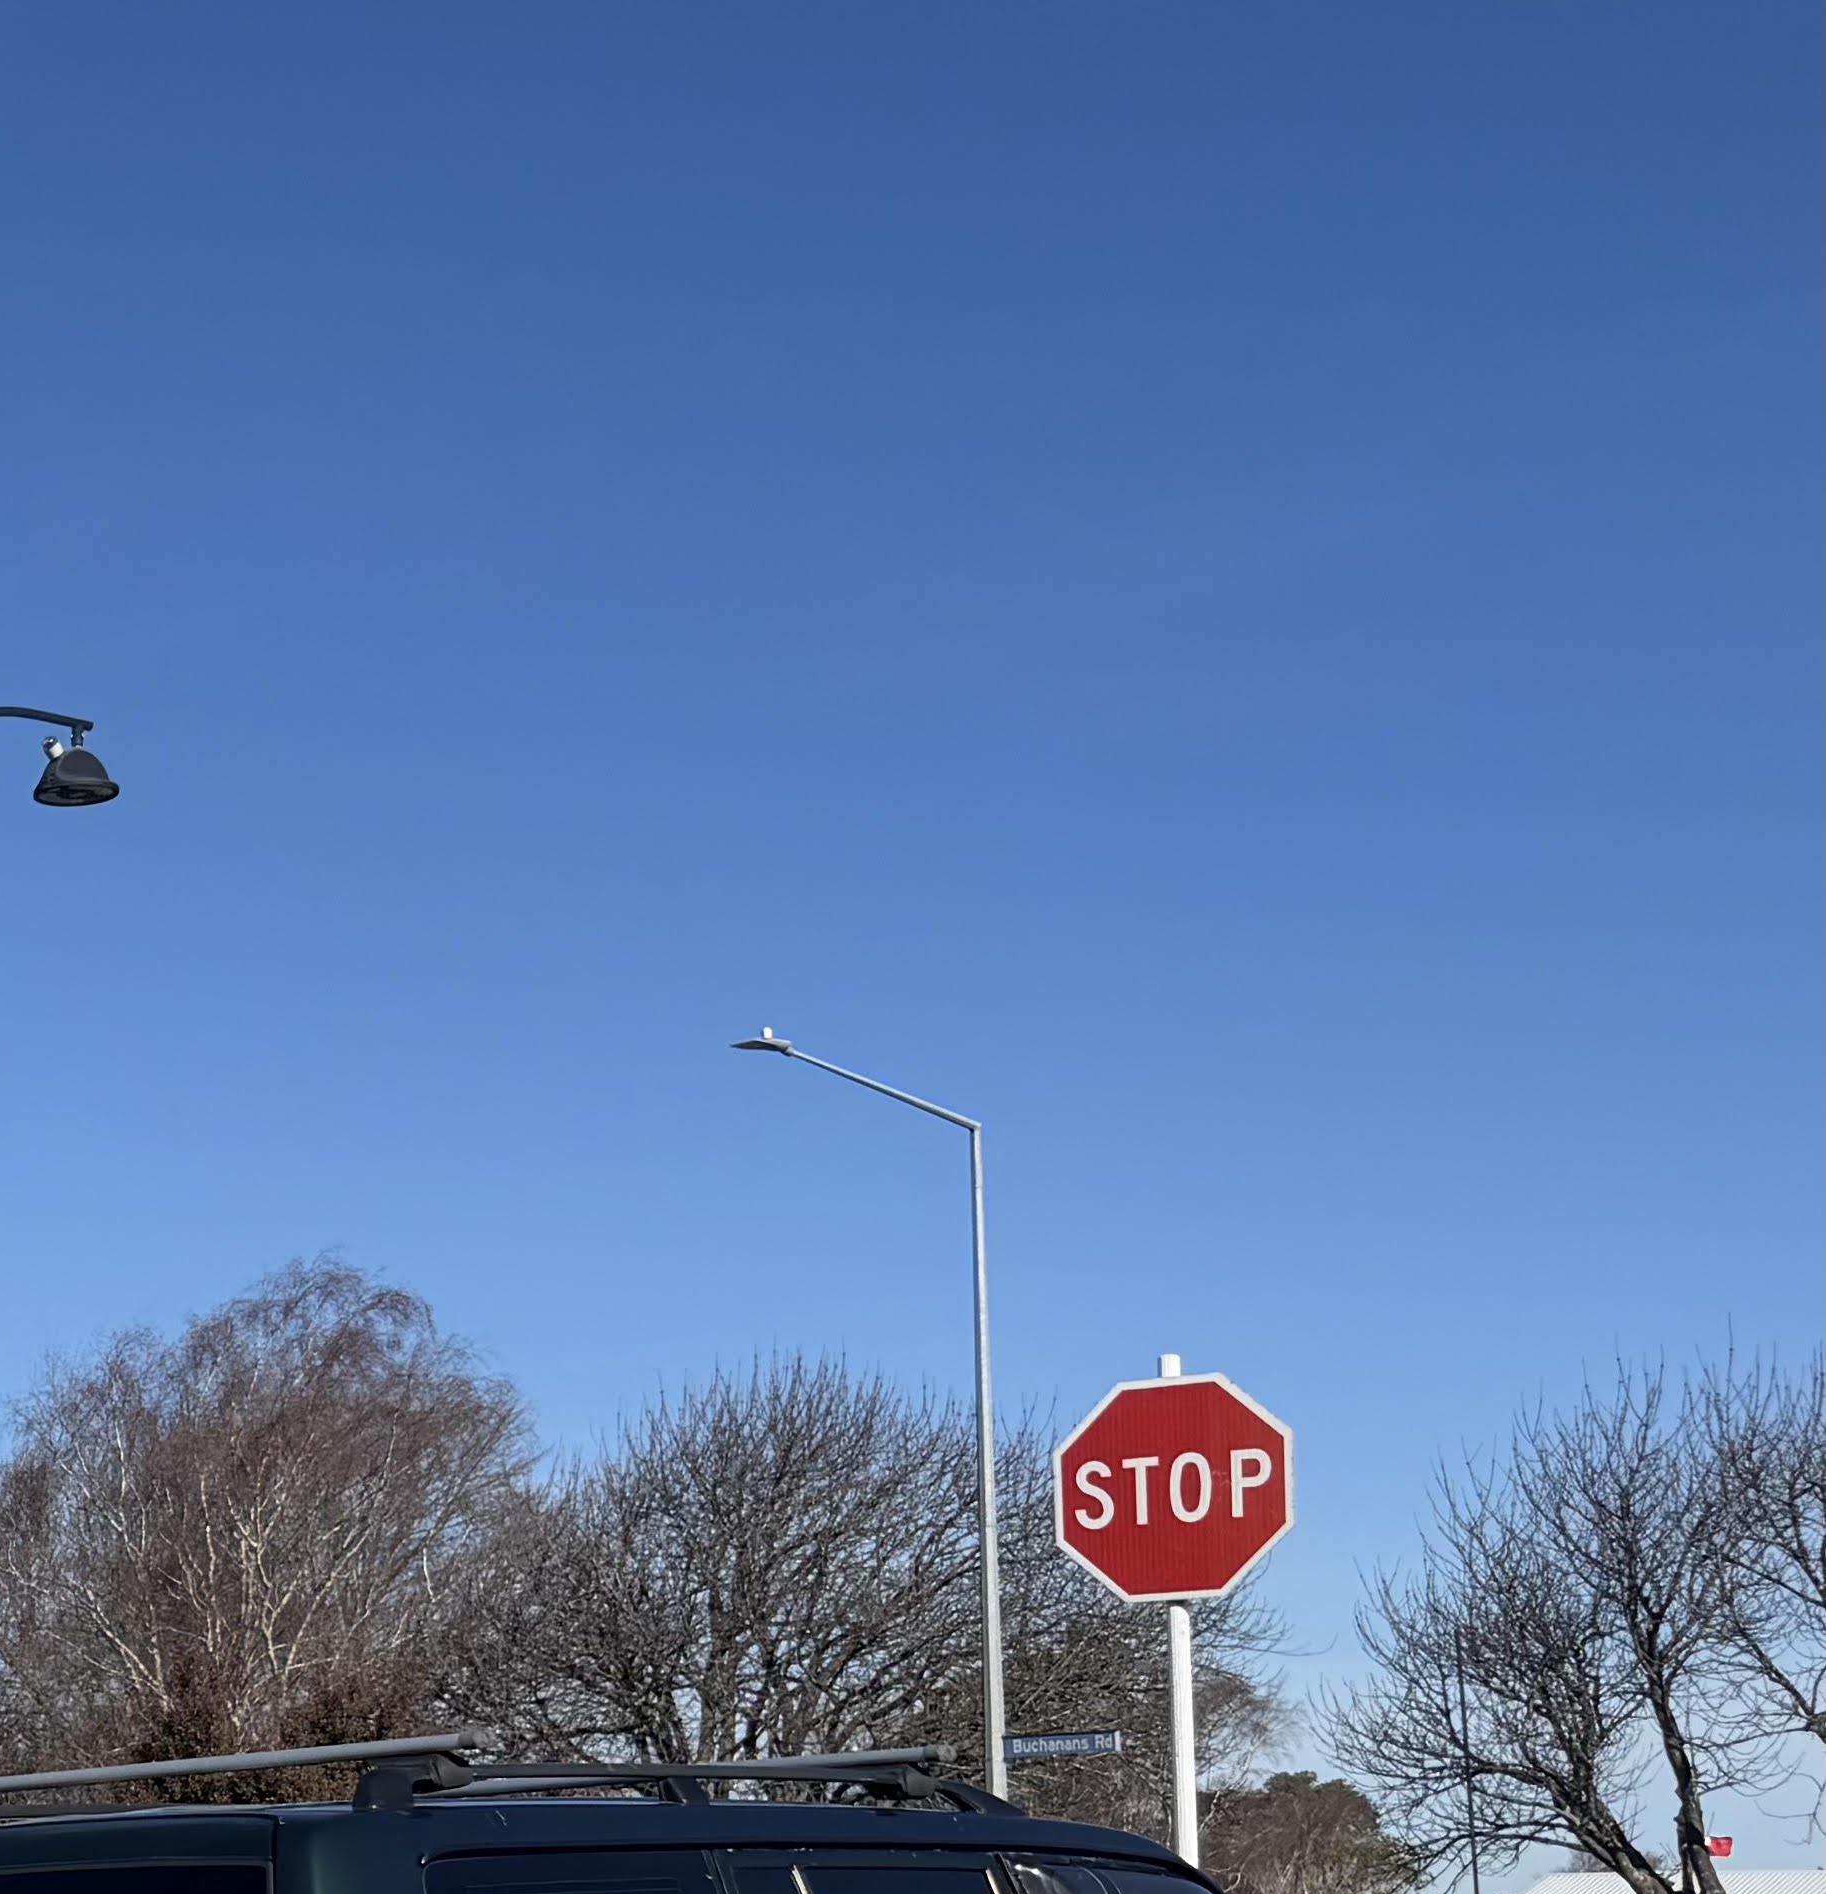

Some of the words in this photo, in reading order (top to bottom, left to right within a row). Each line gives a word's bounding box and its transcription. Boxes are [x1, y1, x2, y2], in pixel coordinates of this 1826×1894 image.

[1074, 1447, 1273, 1531] STOP
[1012, 1738, 1089, 1754] Buchanans
[1093, 1733, 1113, 1750] Rd
